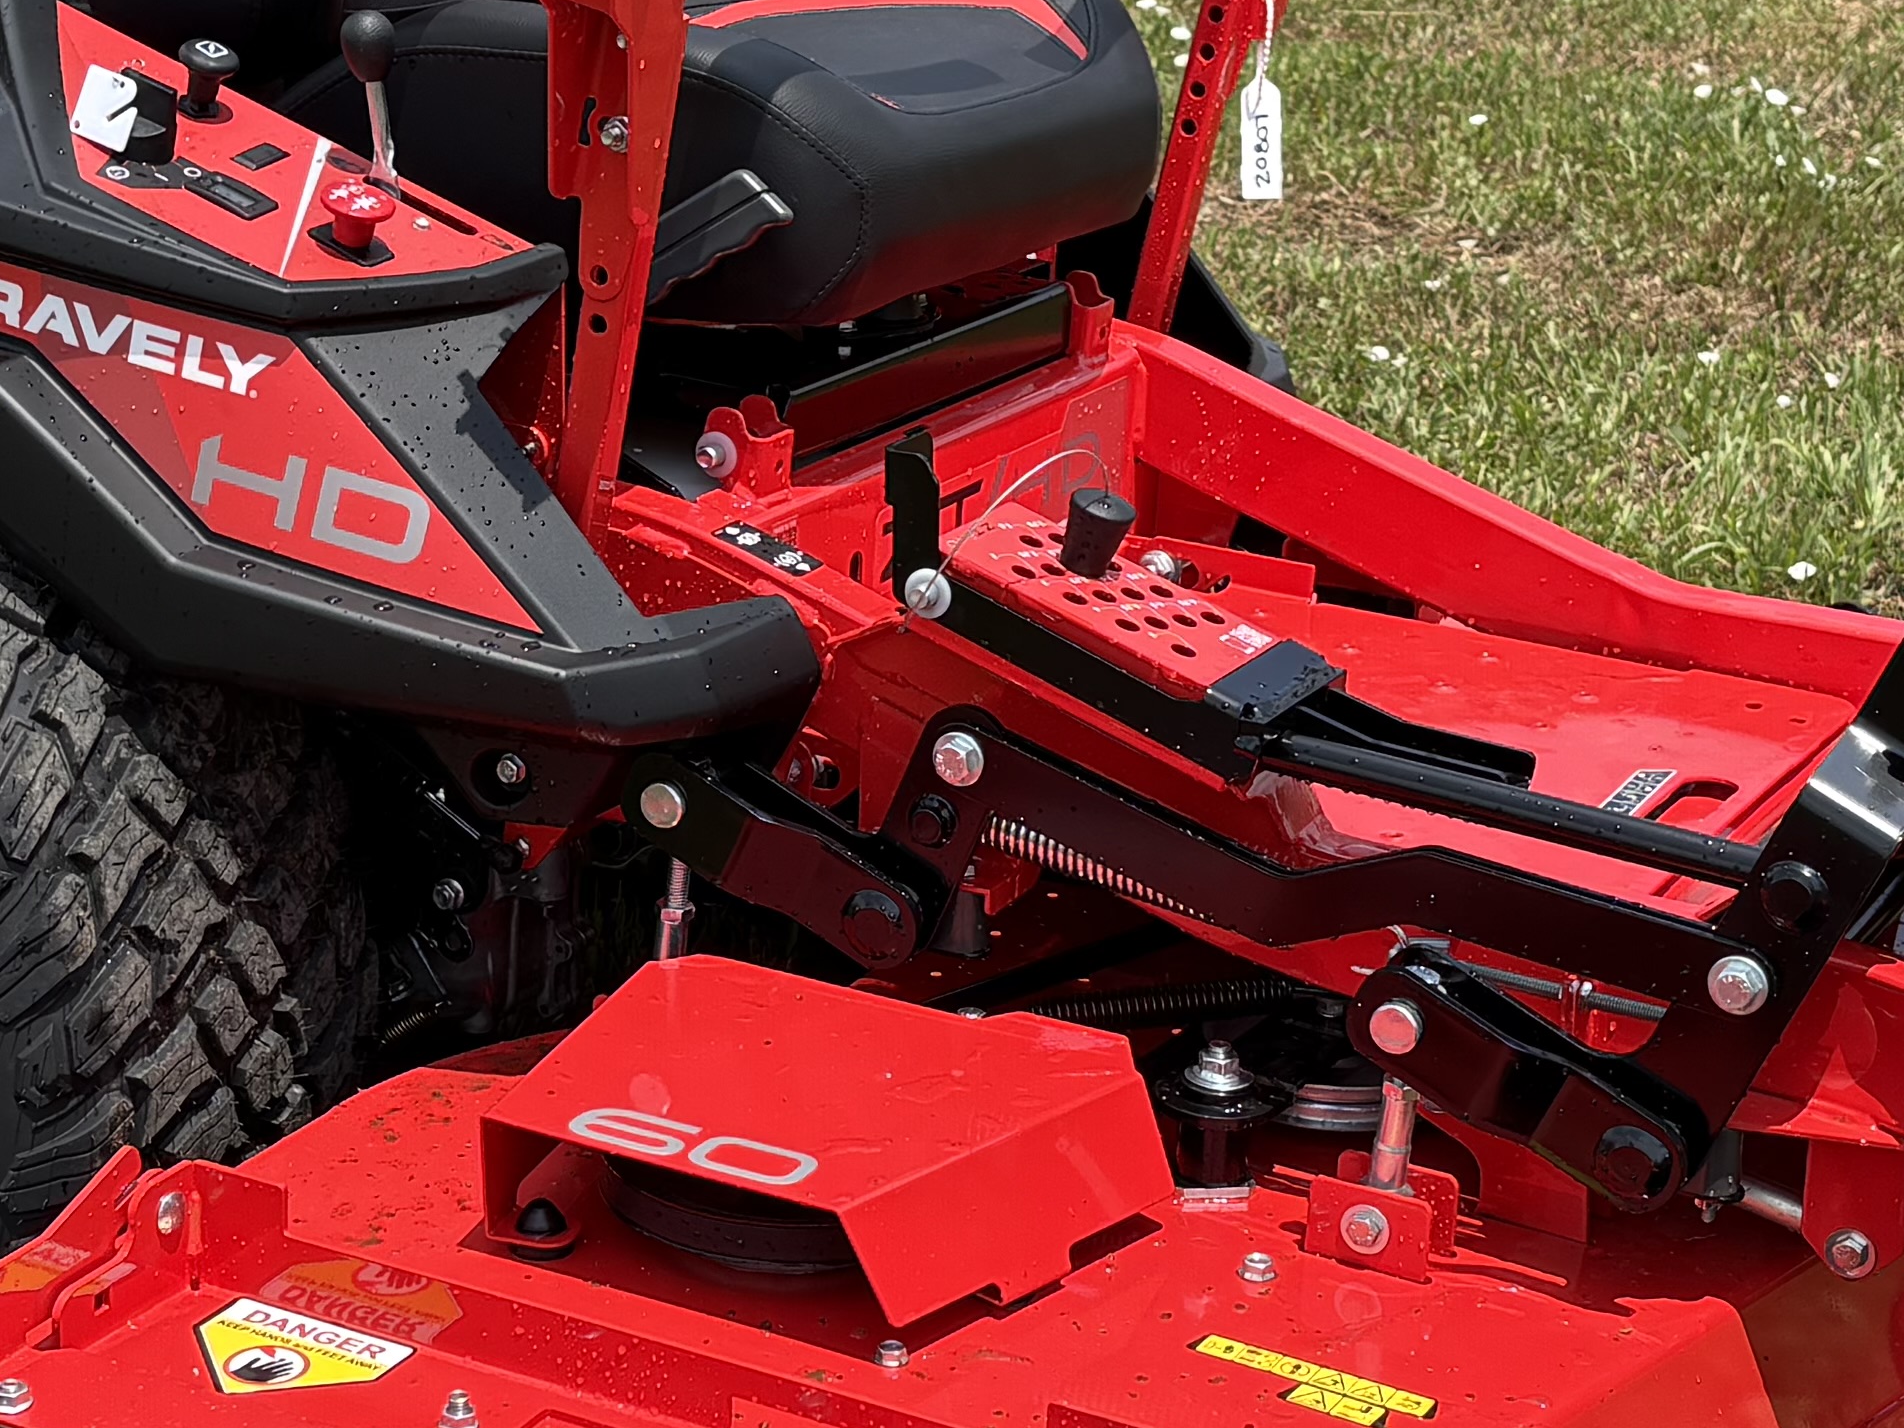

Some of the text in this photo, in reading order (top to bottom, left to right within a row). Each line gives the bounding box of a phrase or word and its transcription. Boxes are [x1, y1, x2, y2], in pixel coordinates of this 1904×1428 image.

[191, 434, 431, 564] HD
[568, 1108, 818, 1185] 60
[242, 1309, 386, 1360] DANGER
